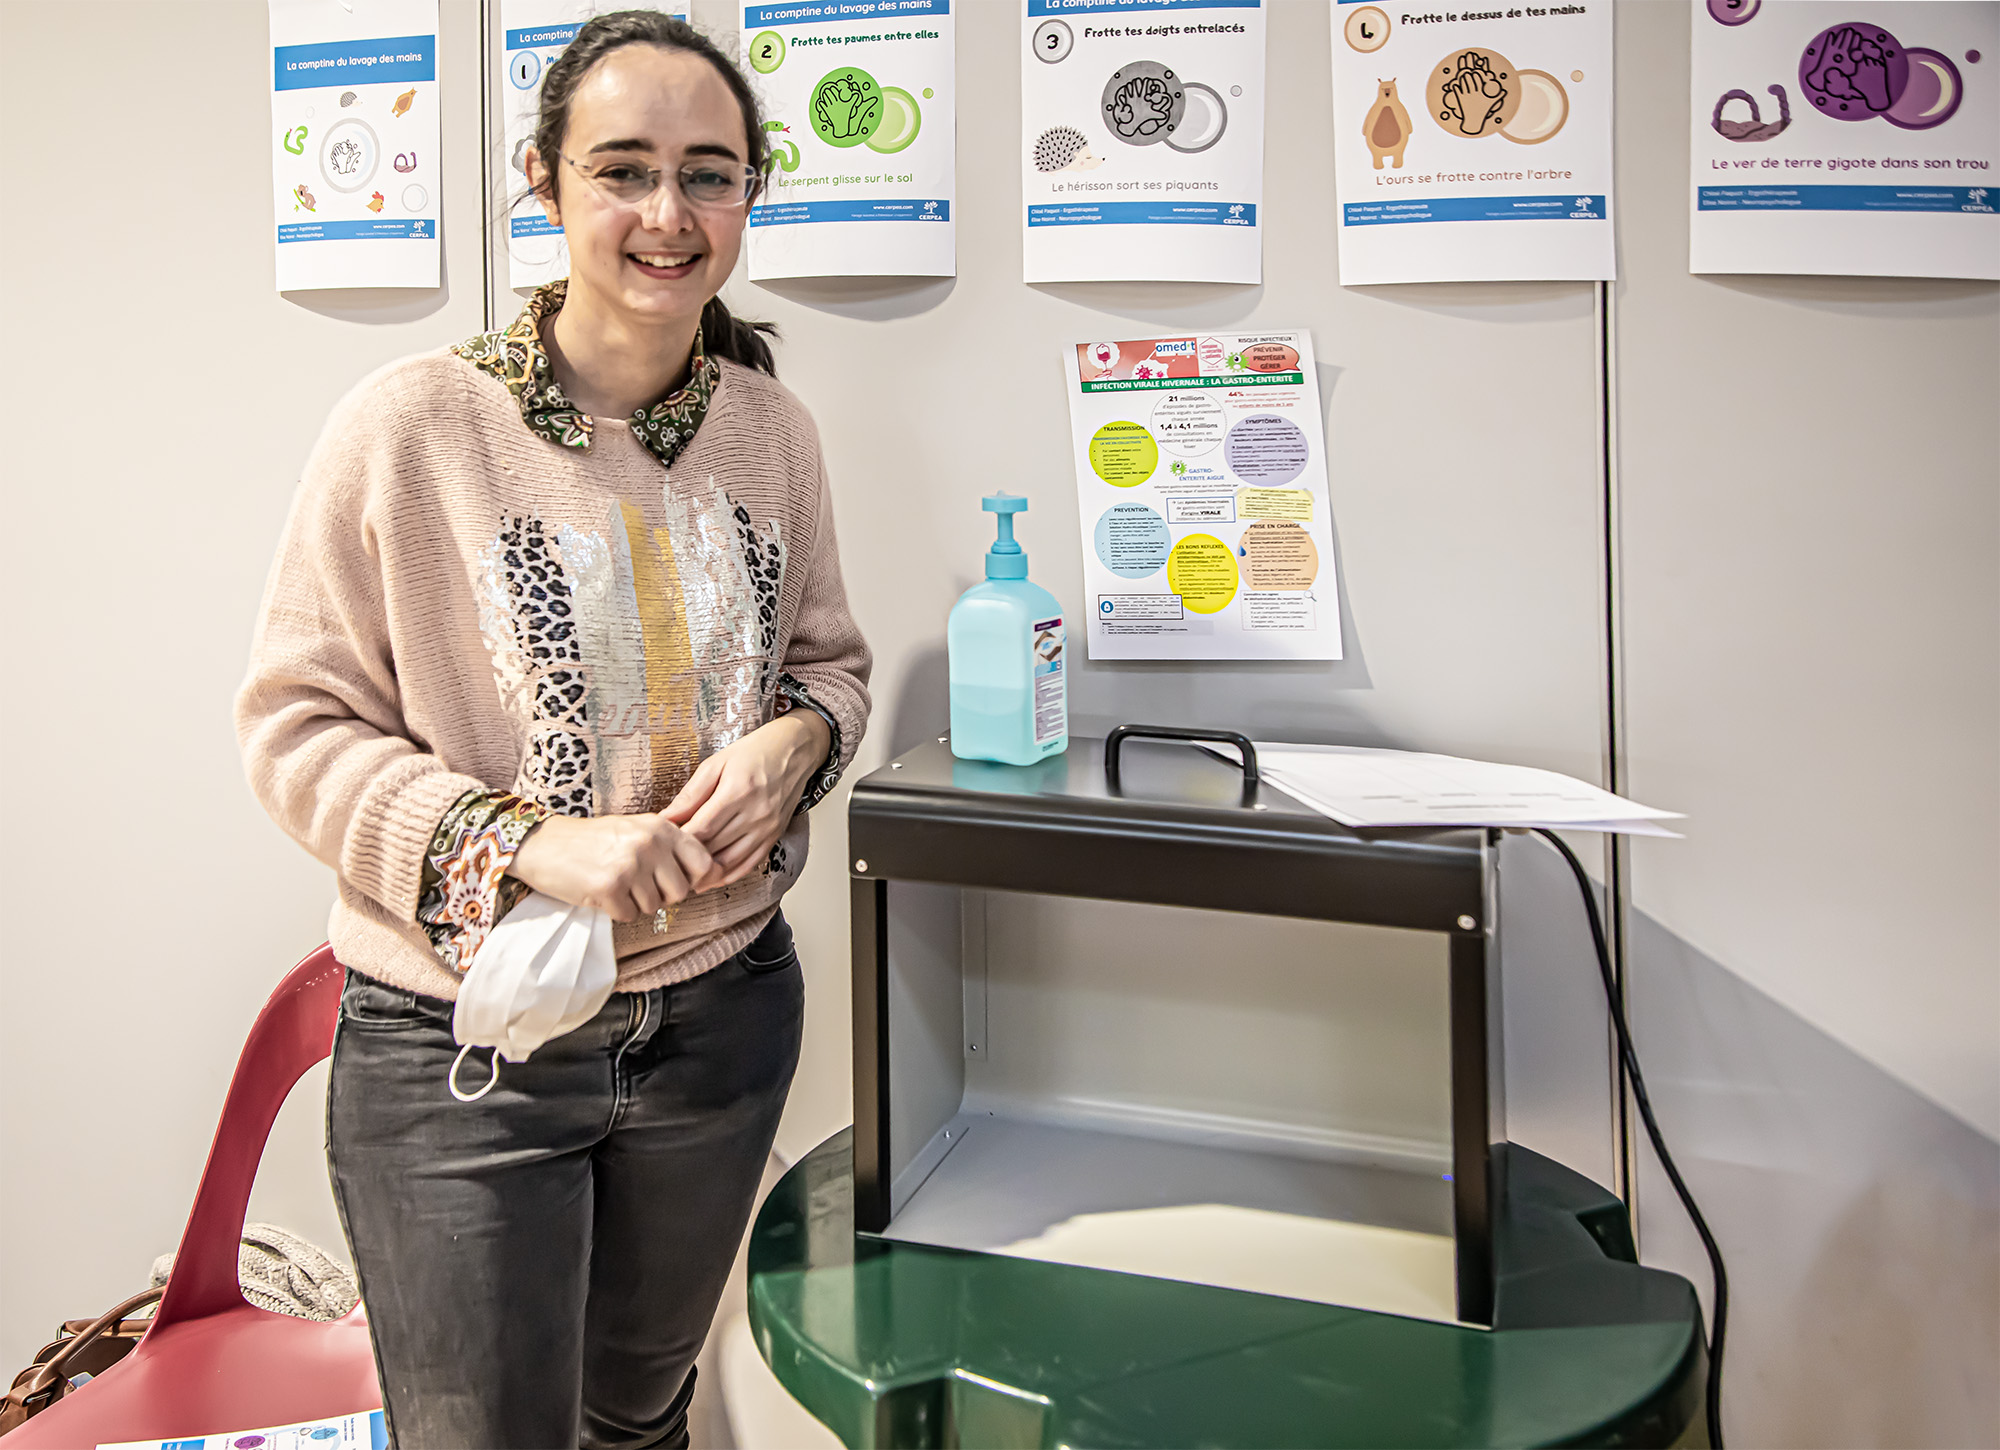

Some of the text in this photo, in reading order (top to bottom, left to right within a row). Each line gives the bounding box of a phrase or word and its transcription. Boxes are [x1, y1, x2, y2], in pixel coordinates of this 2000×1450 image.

[760, 0, 932, 20] La comptine du lavage des mains
[1046, 0, 1059, 8] La
[1401, 4, 1586, 25] Frotte le dessus de tes mains
[520, 30, 573, 42] La comptine
[1085, 23, 1245, 38] Frotte tes doigts entrelacés
[1360, 22, 1374, 39] 4
[791, 30, 939, 47] Frotte tes paumes entre elles
[1046, 34, 1059, 49] 3
[761, 45, 772, 59] 2
[287, 52, 422, 70] La comptine du lavage des mains
[521, 64, 526, 79] 1
[1712, 157, 1989, 170] Le ver de terre gigote dans son trou
[778, 173, 913, 187] Le serpent glisse sur le sol
[1376, 169, 1572, 186] L'ours se frotte contre l'arbre
[1052, 180, 1218, 192] Le hérisson sort ses piquants
[1091, 381, 1131, 390] INFECTION
[1222, 375, 1293, 384] GASTRO-ENTERITE
